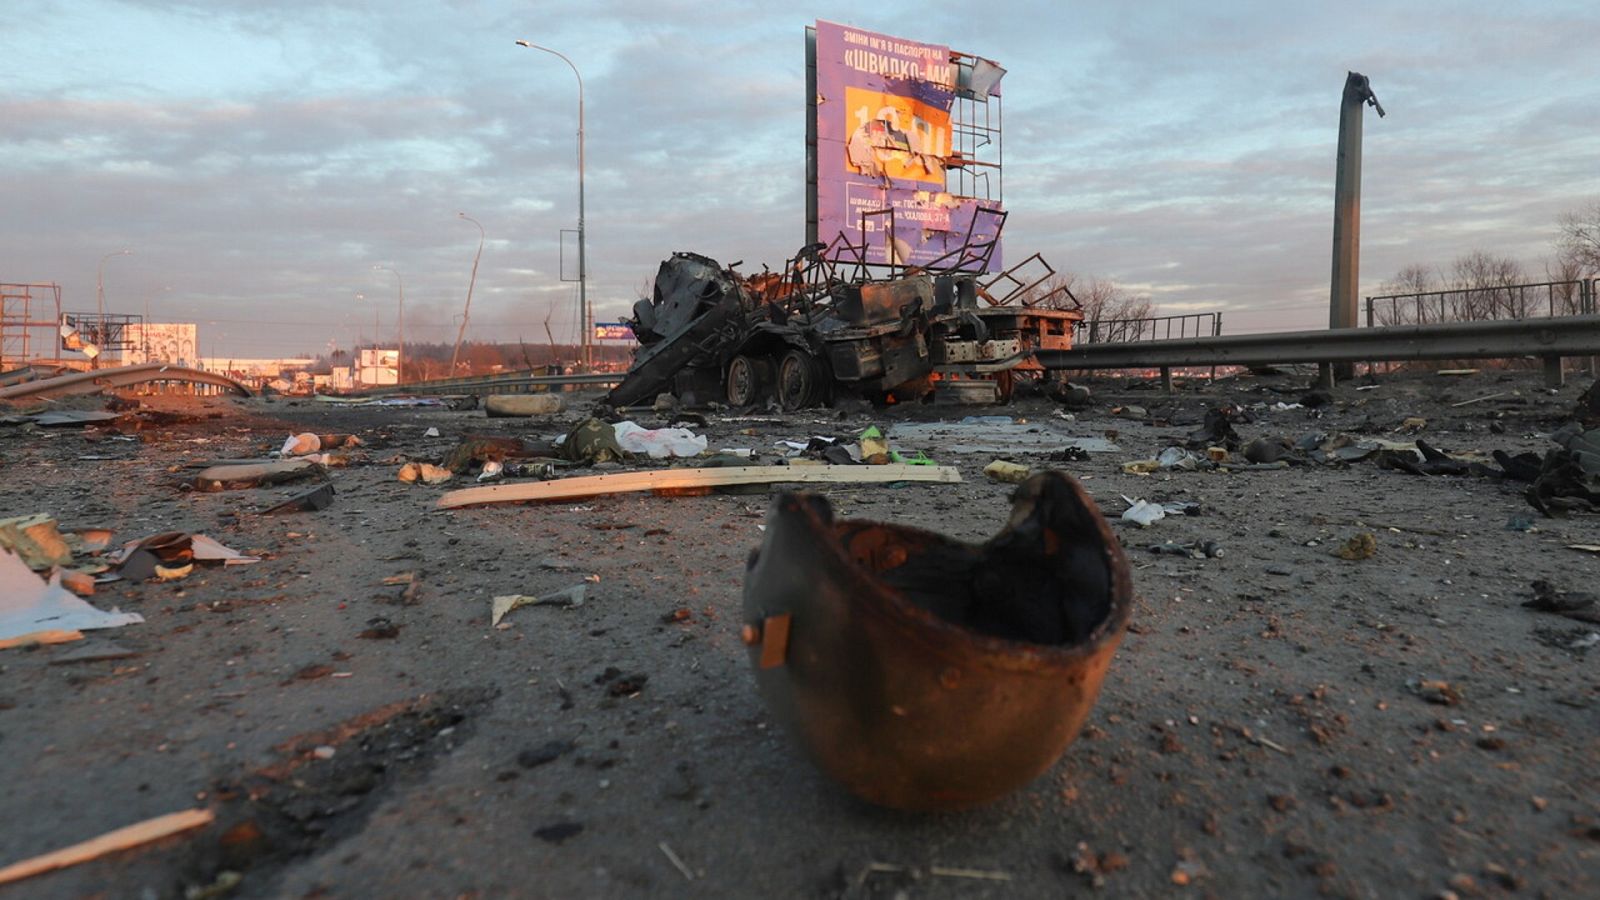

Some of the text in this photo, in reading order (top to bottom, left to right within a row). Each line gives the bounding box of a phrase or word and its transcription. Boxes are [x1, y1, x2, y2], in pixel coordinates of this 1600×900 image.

[843, 30, 869, 46] ЗМІНИ
[894, 42, 931, 58] ПАСПОРТІ
[932, 49, 943, 60] НА
